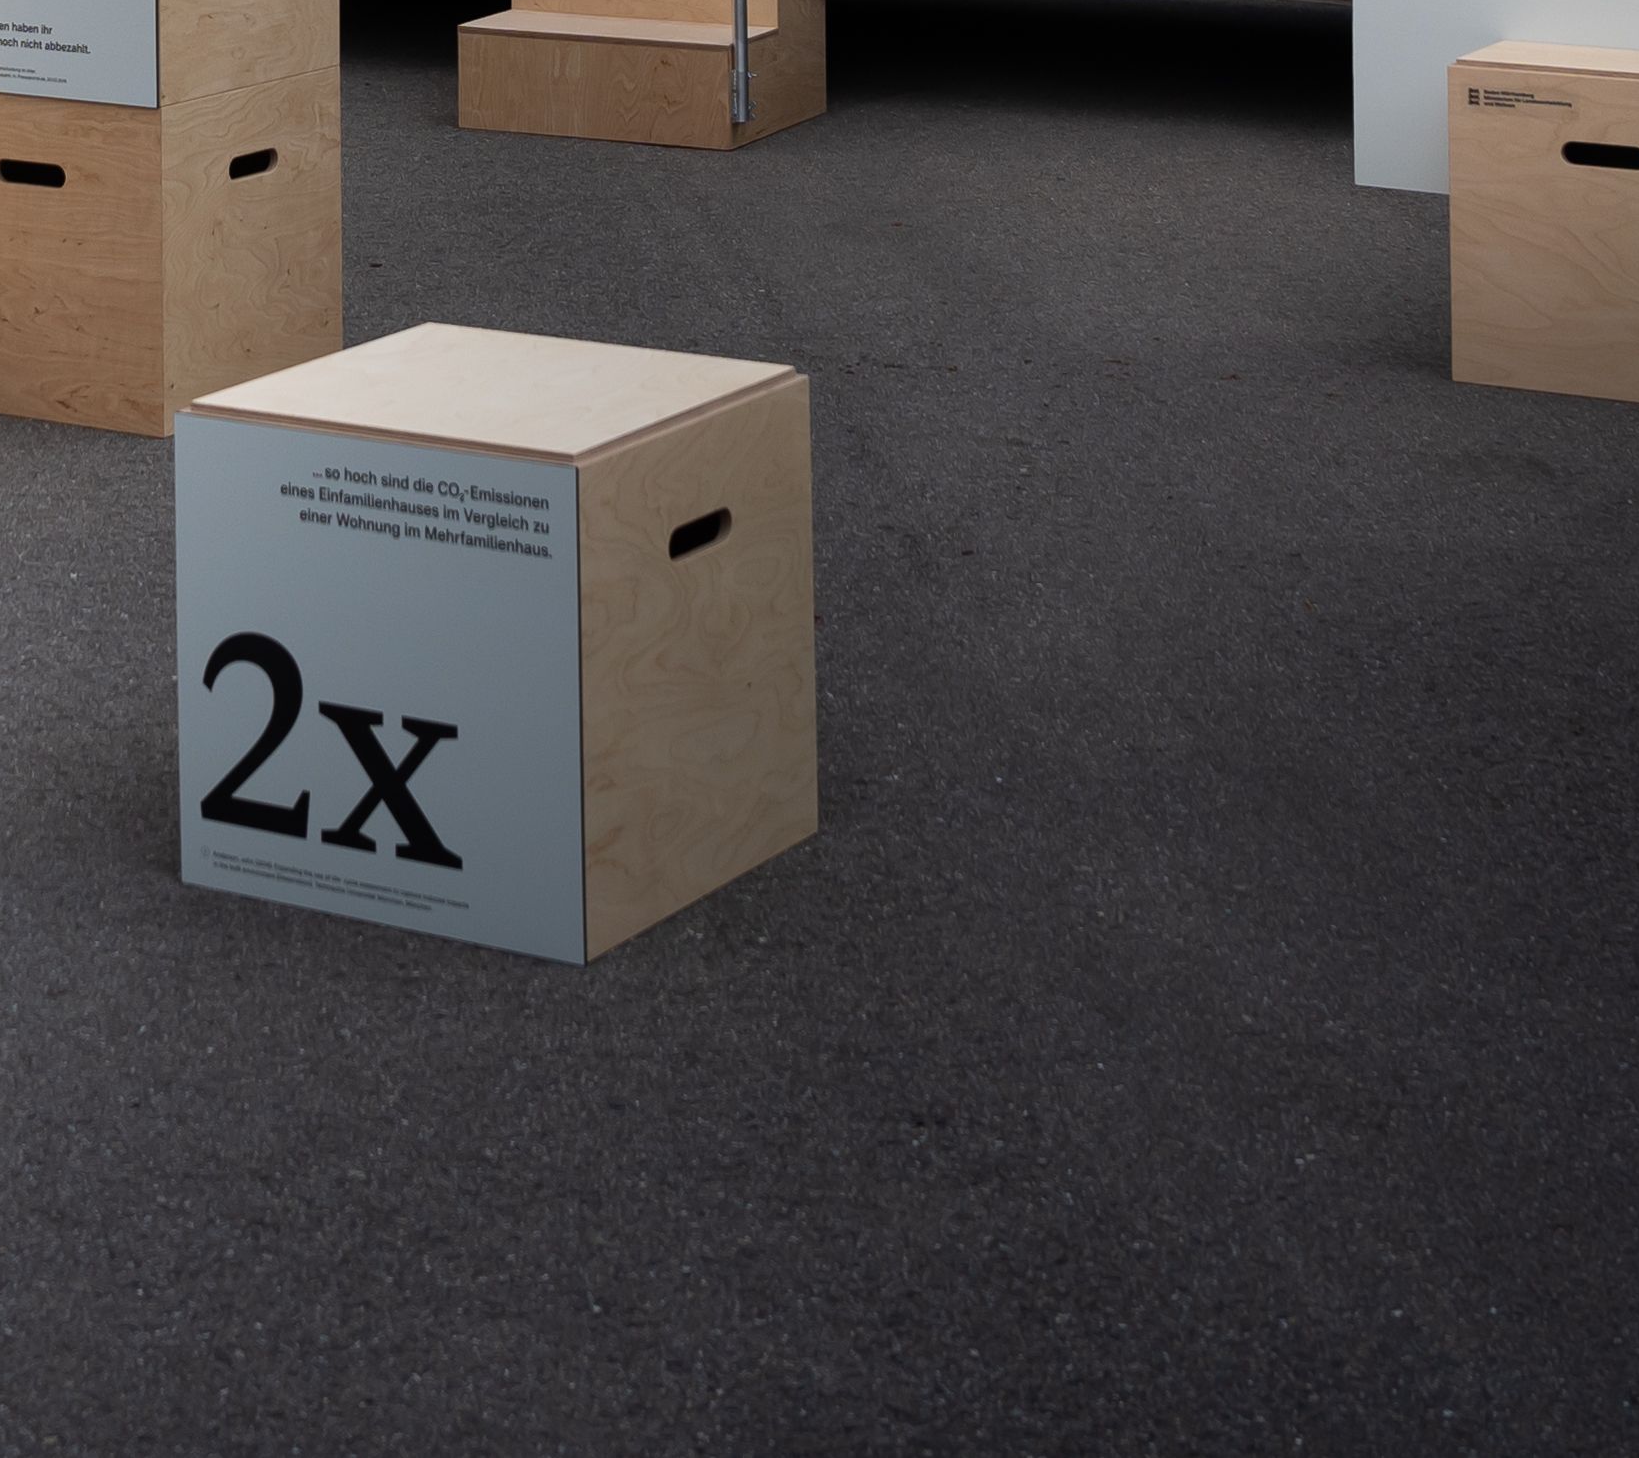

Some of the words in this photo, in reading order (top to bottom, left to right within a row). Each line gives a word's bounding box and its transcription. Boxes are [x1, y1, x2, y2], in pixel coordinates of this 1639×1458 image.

[11, 21, 39, 34] haben
[40, 24, 53, 35] ihr
[20, 38, 43, 50] nicht
[44, 40, 91, 54] abbezahlt.
[343, 469, 377, 486] hoch
[380, 474, 409, 491] sind
[412, 477, 434, 494] die
[280, 482, 315, 501] eines
[318, 486, 439, 519] Einfamilienhauses
[442, 504, 460, 521] im
[463, 507, 529, 531] Vergleich
[533, 520, 550, 535] zu
[299, 508, 332, 525] einer
[336, 512, 401, 537] Wohnung
[404, 522, 421, 539] im
[424, 525, 552, 559] Mehrfamilienhaus.
[200, 631, 462, 871] 2x
